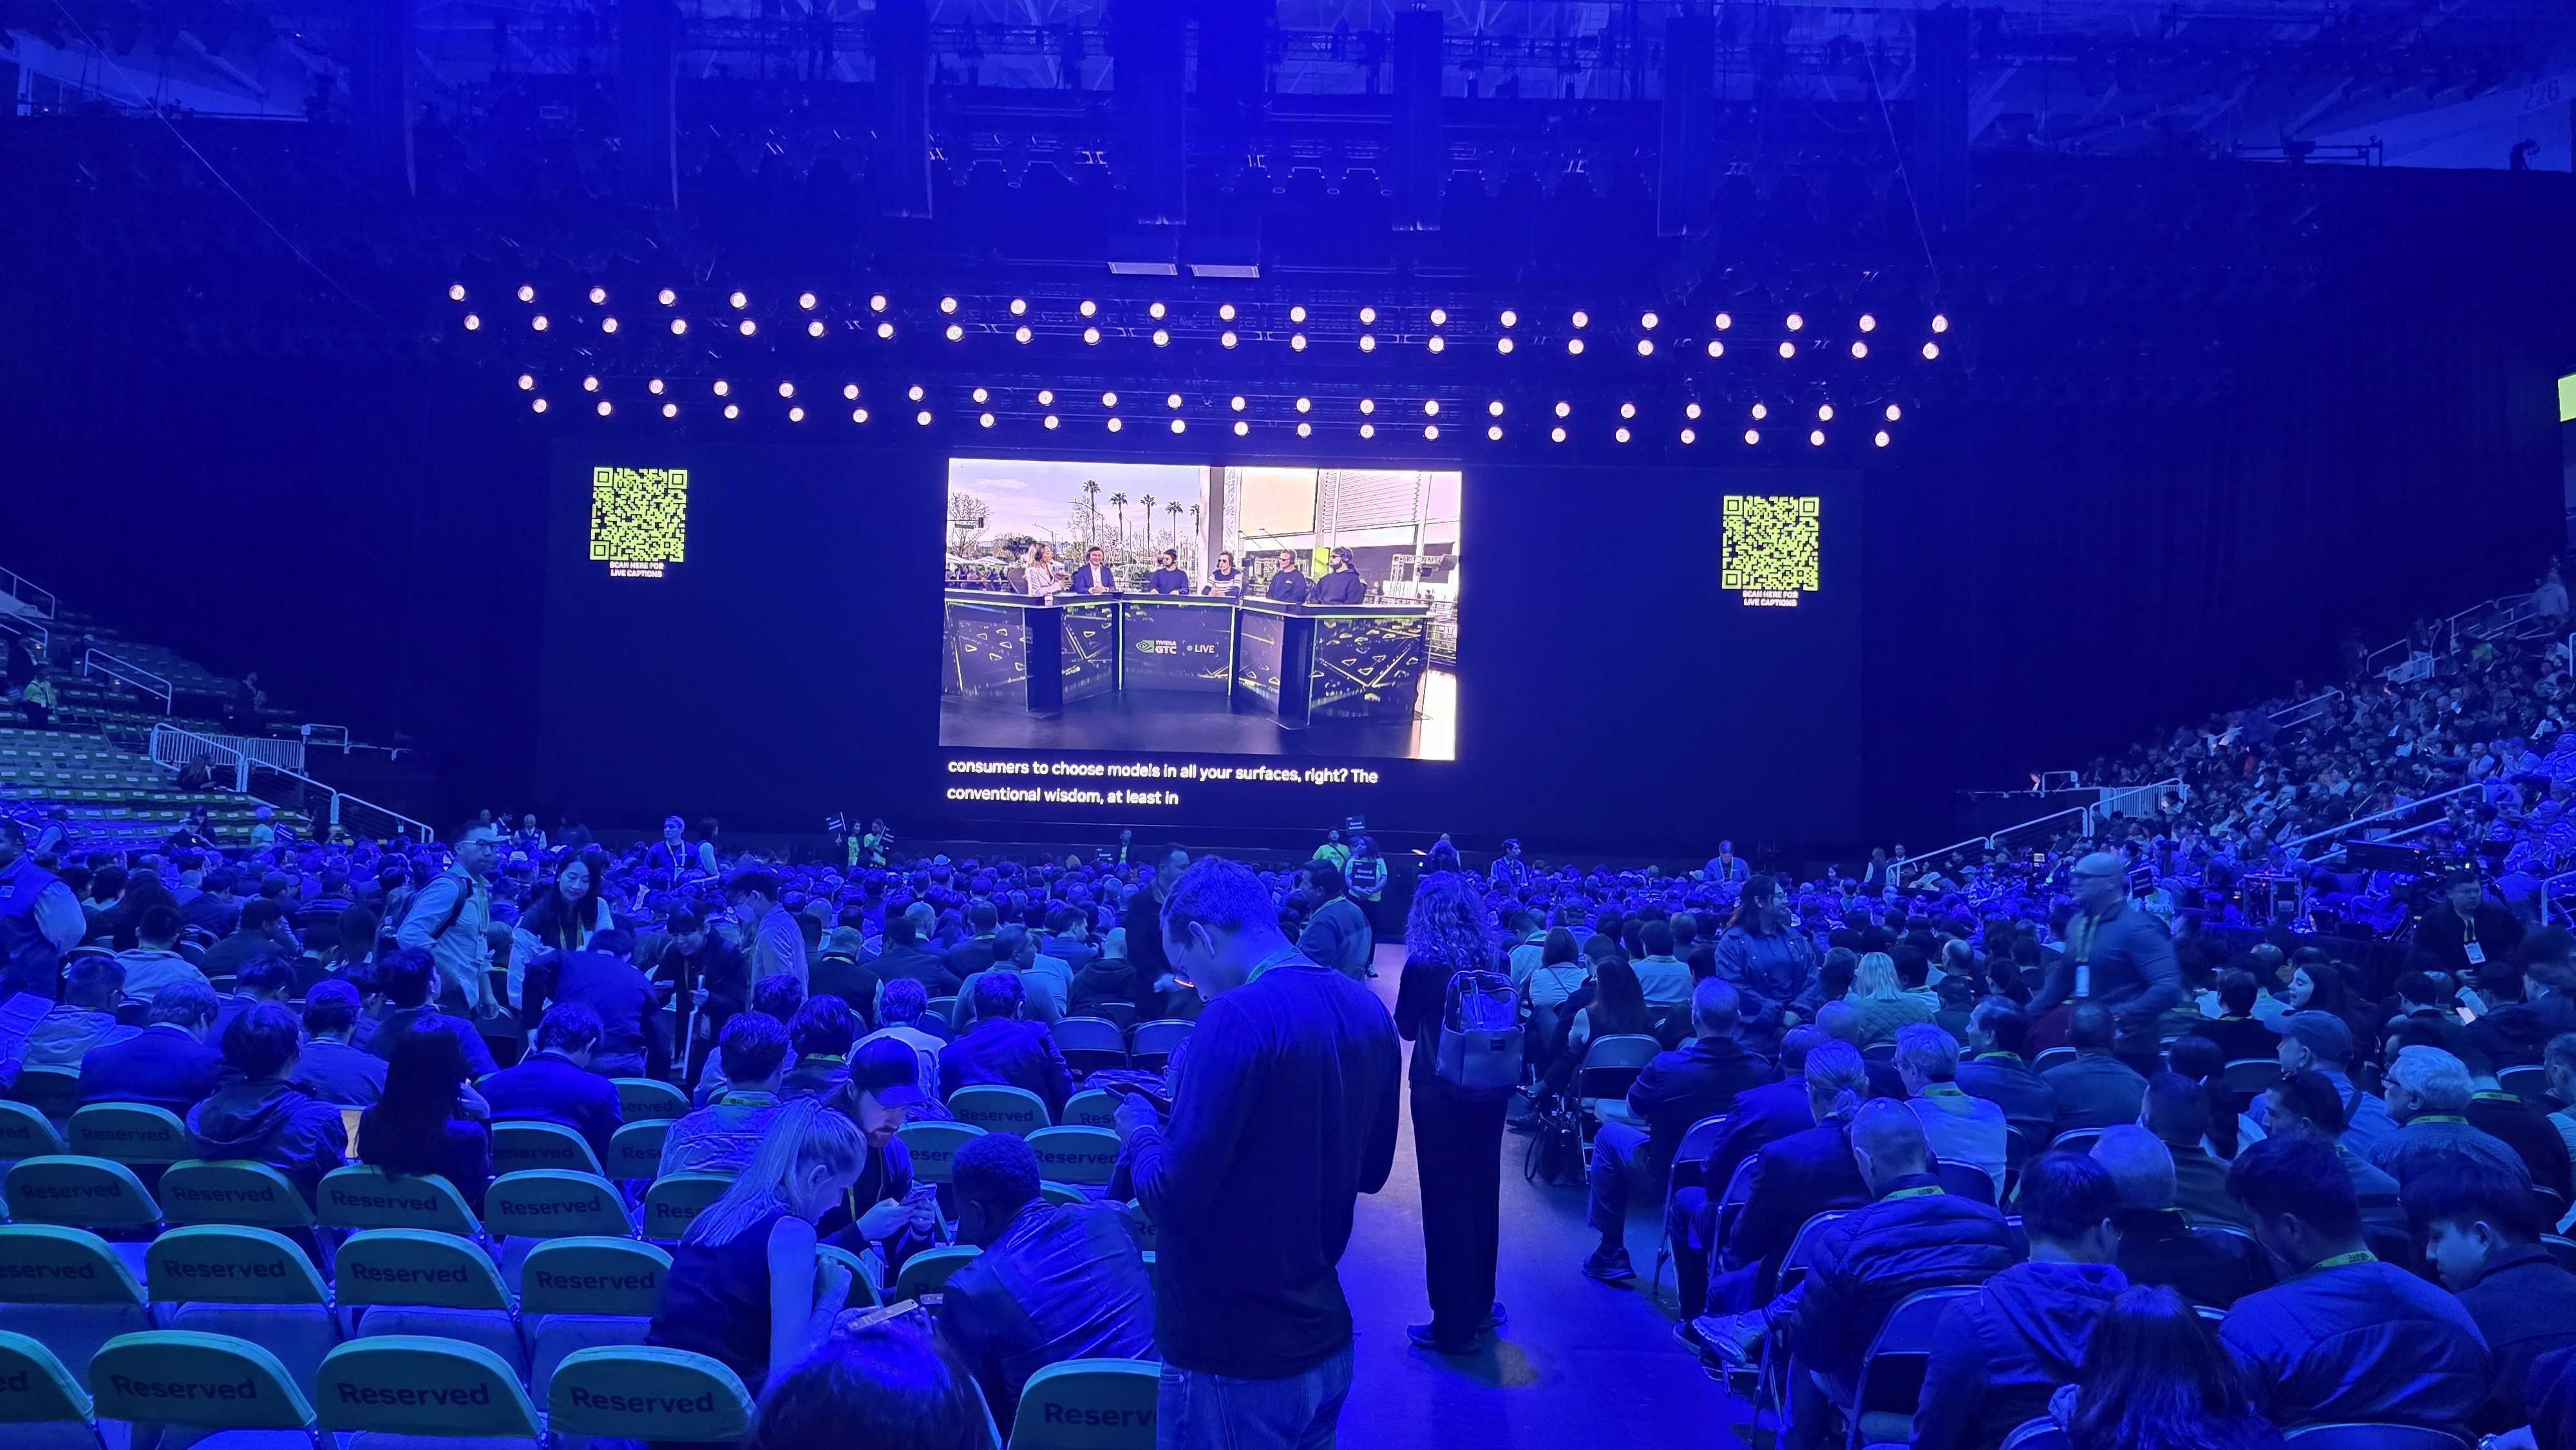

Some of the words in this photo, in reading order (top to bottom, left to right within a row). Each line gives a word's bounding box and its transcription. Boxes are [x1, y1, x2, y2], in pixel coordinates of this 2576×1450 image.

[1155, 646, 1177, 655] GTC
[1195, 645, 1215, 654] LIVE
[948, 761, 1029, 774] consumers
[1032, 761, 1049, 775] to
[1052, 761, 1104, 777] choose
[1108, 763, 1160, 777] models
[1164, 764, 1177, 778] in
[1180, 764, 1197, 778] all
[1200, 767, 1233, 782] your
[1235, 766, 1302, 783] surfaces,
[1305, 768, 1347, 785] right?
[1350, 769, 1378, 783] The
[947, 787, 1041, 802] conventional
[1044, 788, 1104, 805] wisdom,
[1107, 791, 1123, 804] at
[1126, 790, 1162, 804] least
[1165, 791, 1179, 805] in
[621, 1100, 673, 1112] served
[959, 1108, 1034, 1122] Reserved
[80, 1128, 171, 1142] Reserved
[493, 1146, 574, 1160] eserved
[909, 1149, 952, 1162] eser
[20, 1182, 122, 1200] Reserved
[171, 1185, 276, 1202] Reserved
[330, 1190, 438, 1212] Reserved
[499, 1196, 601, 1215] Reserved
[162, 1259, 287, 1278] Reserved
[350, 1262, 469, 1284] Reserved
[536, 1270, 654, 1290] Reserved
[110, 1372, 259, 1400] Reserved
[337, 1382, 491, 1407] Reserved
[570, 1386, 714, 1413] Reserved
[1044, 1402, 1157, 1427] Reserv
